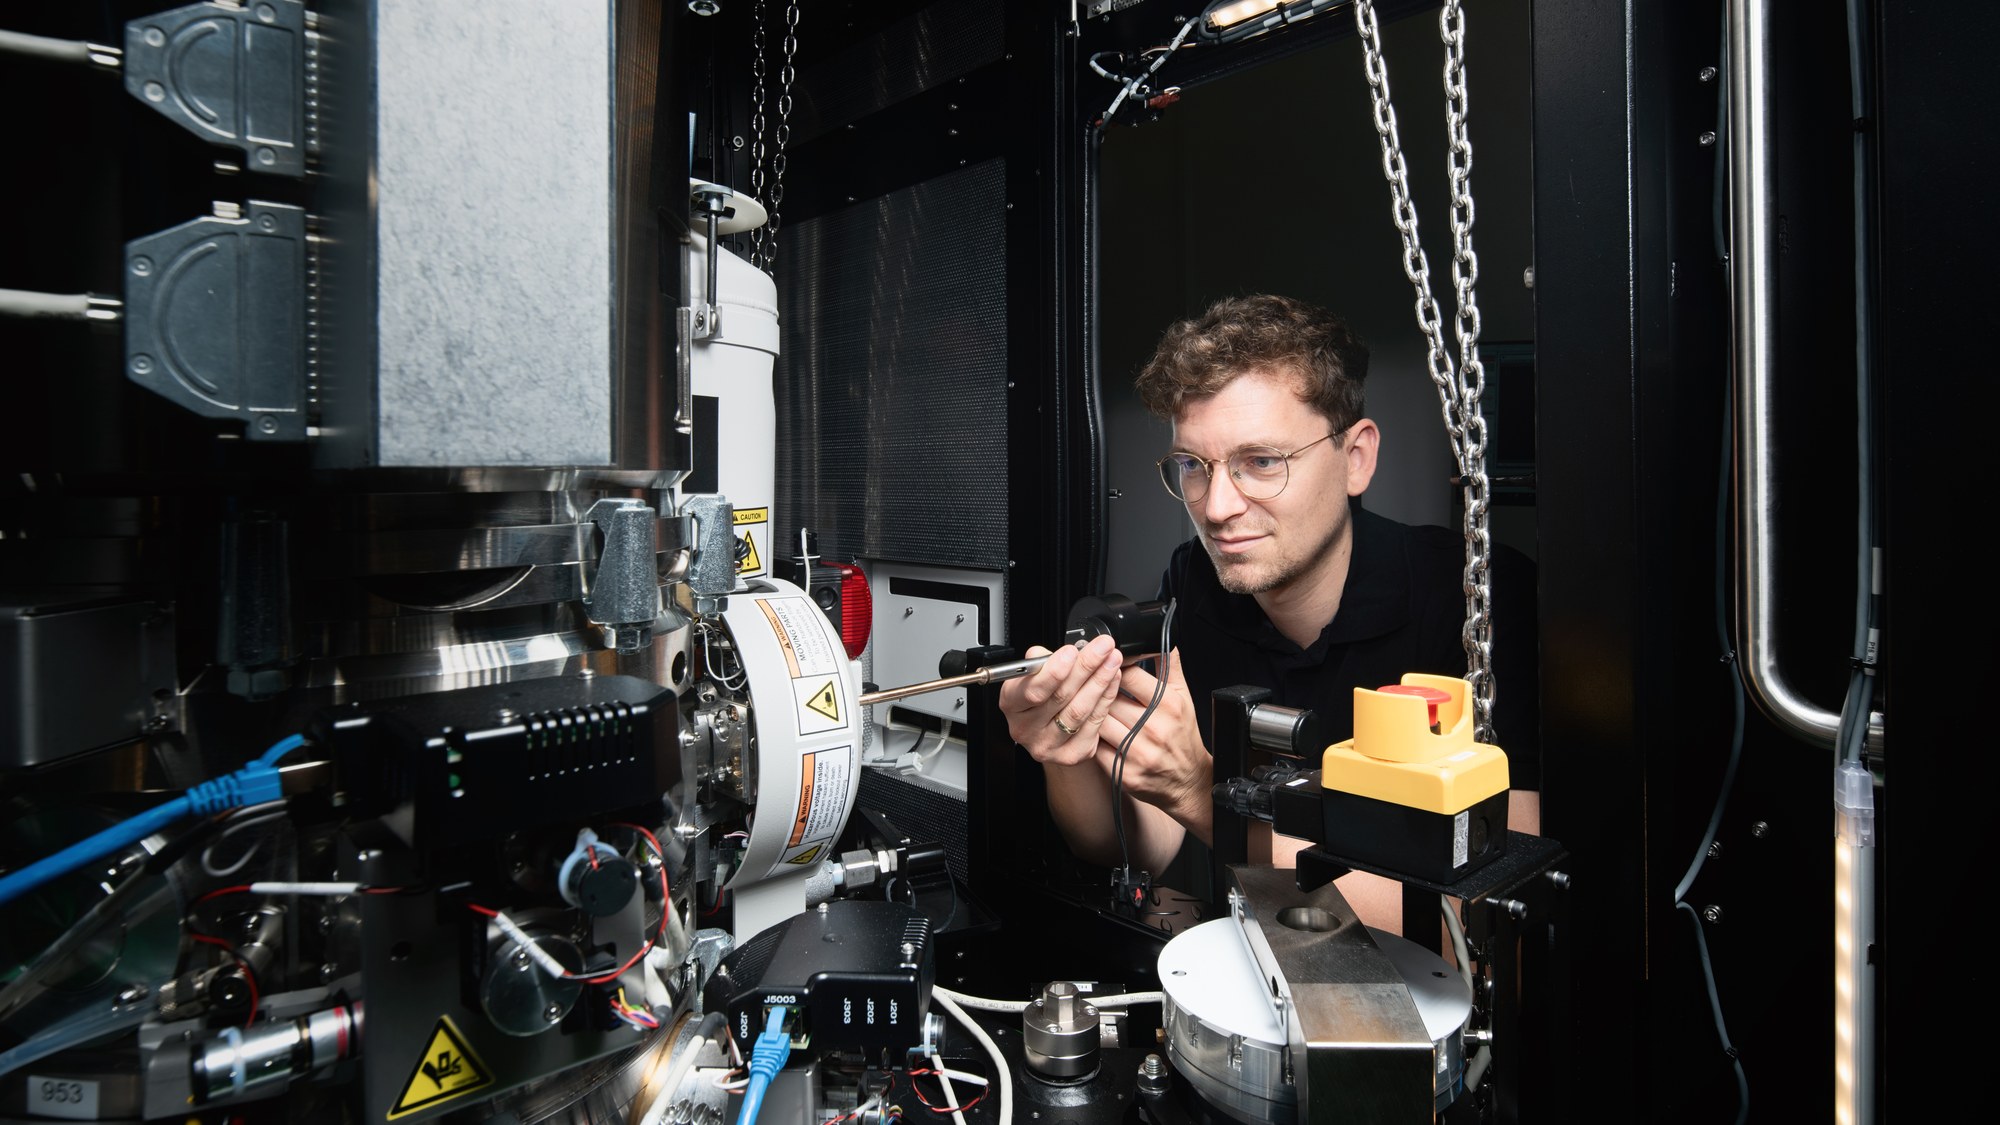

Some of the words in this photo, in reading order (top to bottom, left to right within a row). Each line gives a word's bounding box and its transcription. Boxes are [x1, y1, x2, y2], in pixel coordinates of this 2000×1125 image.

[740, 512, 762, 521] CAUTION
[770, 616, 787, 642] WARNING
[776, 607, 793, 628] PARTS
[789, 629, 806, 661] MOVING
[801, 785, 810, 815] WARNING
[804, 809, 818, 838] Hazardous
[764, 995, 797, 1004] J5003
[843, 998, 851, 1025] J303
[867, 998, 875, 1025] J202
[890, 999, 898, 1025] J201
[740, 1011, 749, 1039] J200
[41, 1080, 84, 1105] 953
